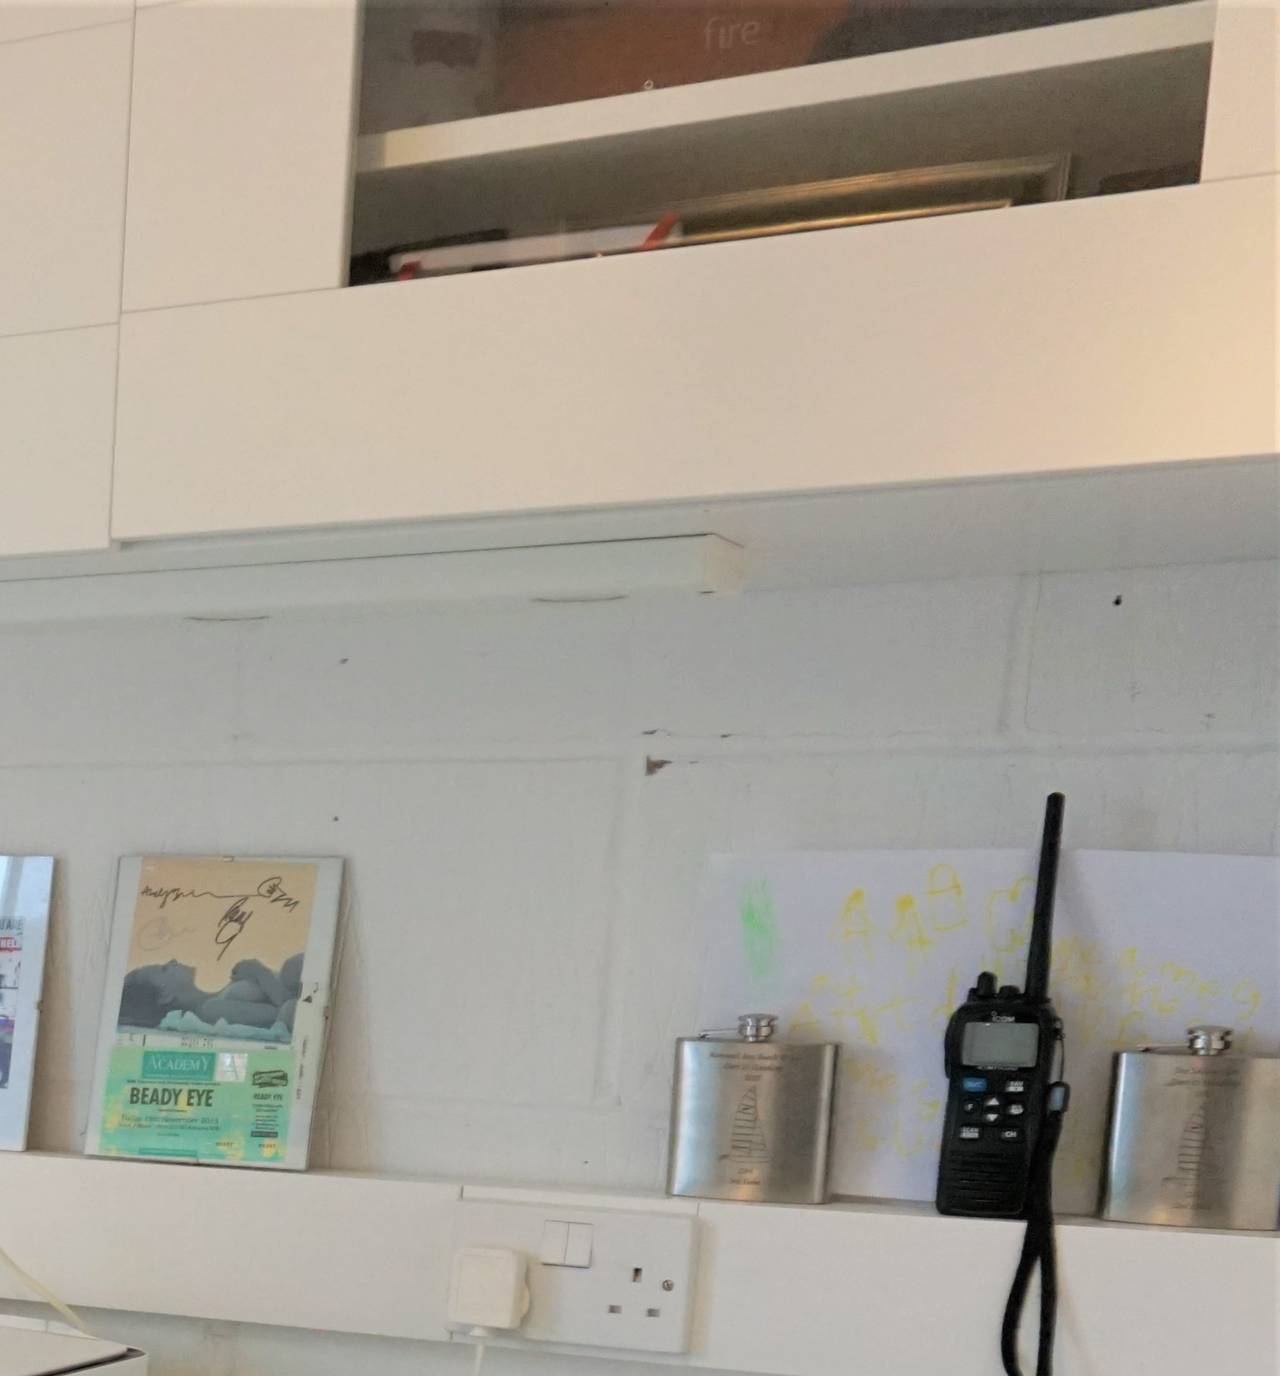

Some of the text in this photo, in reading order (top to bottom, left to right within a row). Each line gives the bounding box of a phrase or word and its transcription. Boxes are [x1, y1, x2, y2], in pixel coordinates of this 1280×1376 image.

[704, 16, 761, 52] fire
[149, 1054, 211, 1072] ACADEMY
[129, 1087, 214, 1107] BEADY EYE
